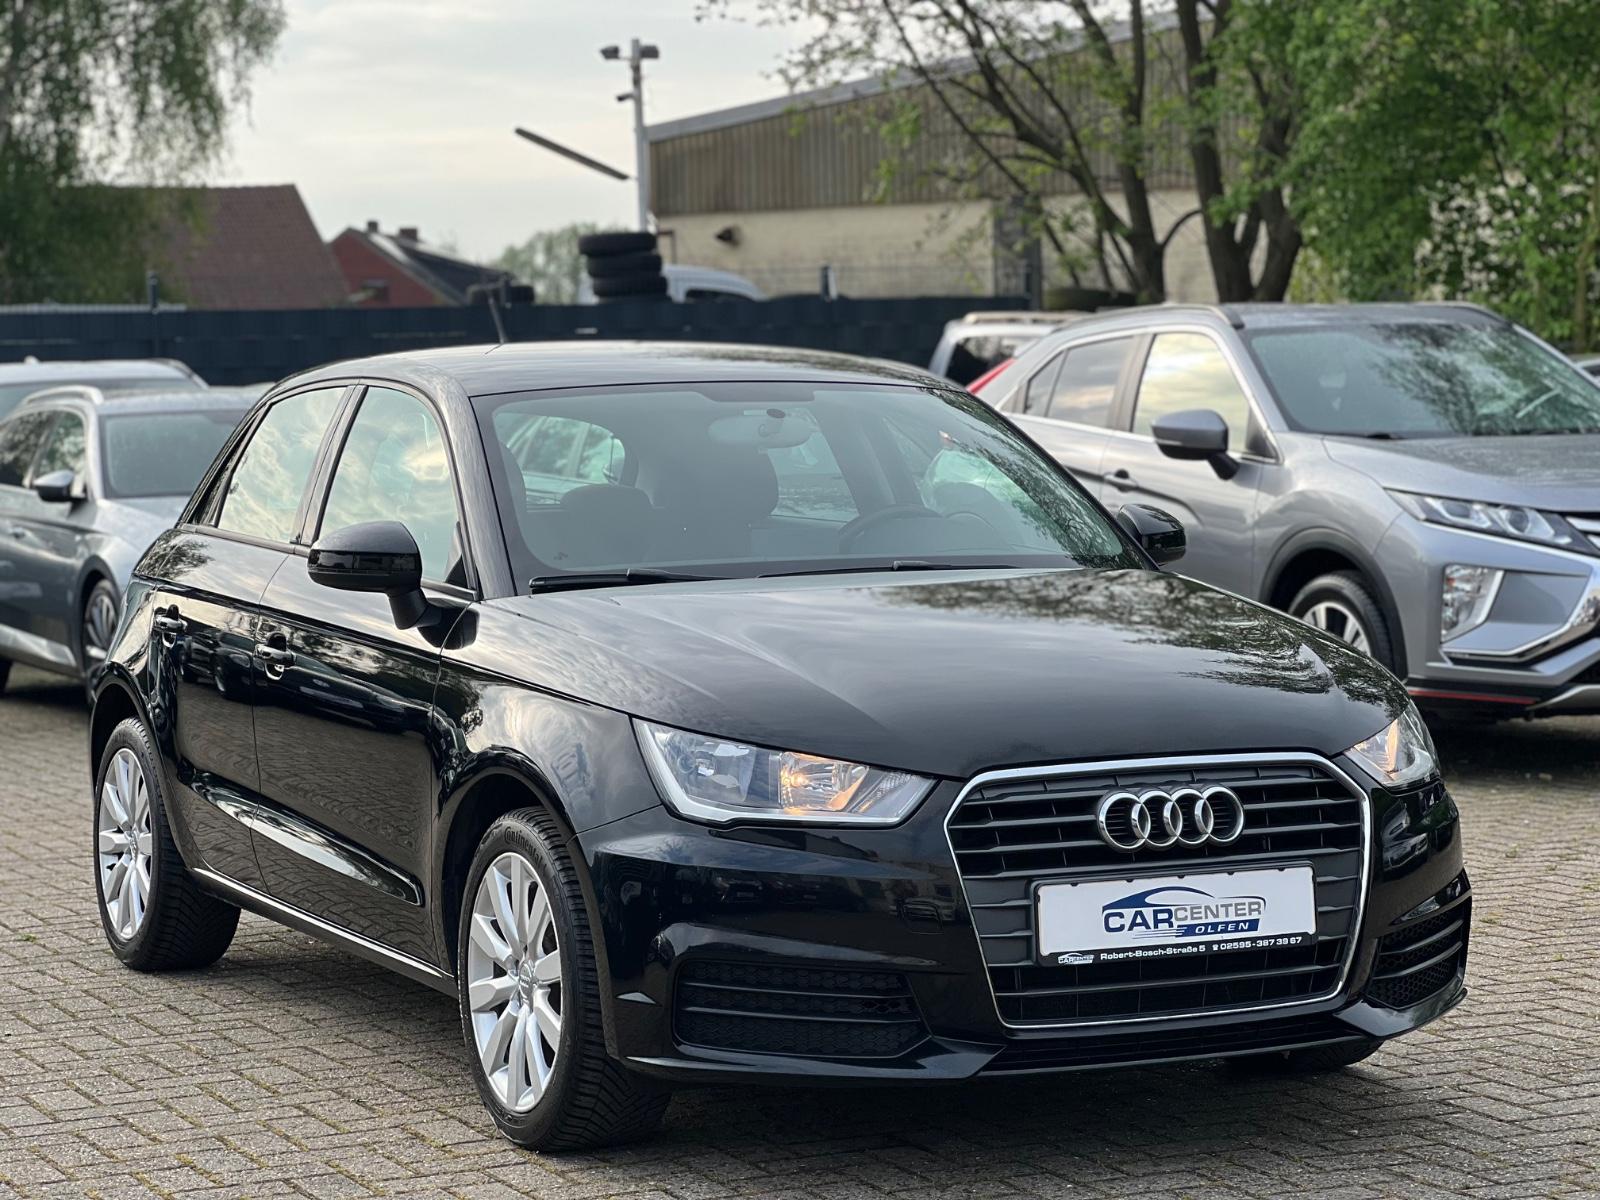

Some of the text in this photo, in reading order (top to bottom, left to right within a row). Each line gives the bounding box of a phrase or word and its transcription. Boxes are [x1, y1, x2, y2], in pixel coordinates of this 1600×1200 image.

[504, 826, 543, 868] Continental
[1195, 921, 1250, 934] OLFEN
[1100, 946, 1198, 960] Robert-Bosch-Straße
